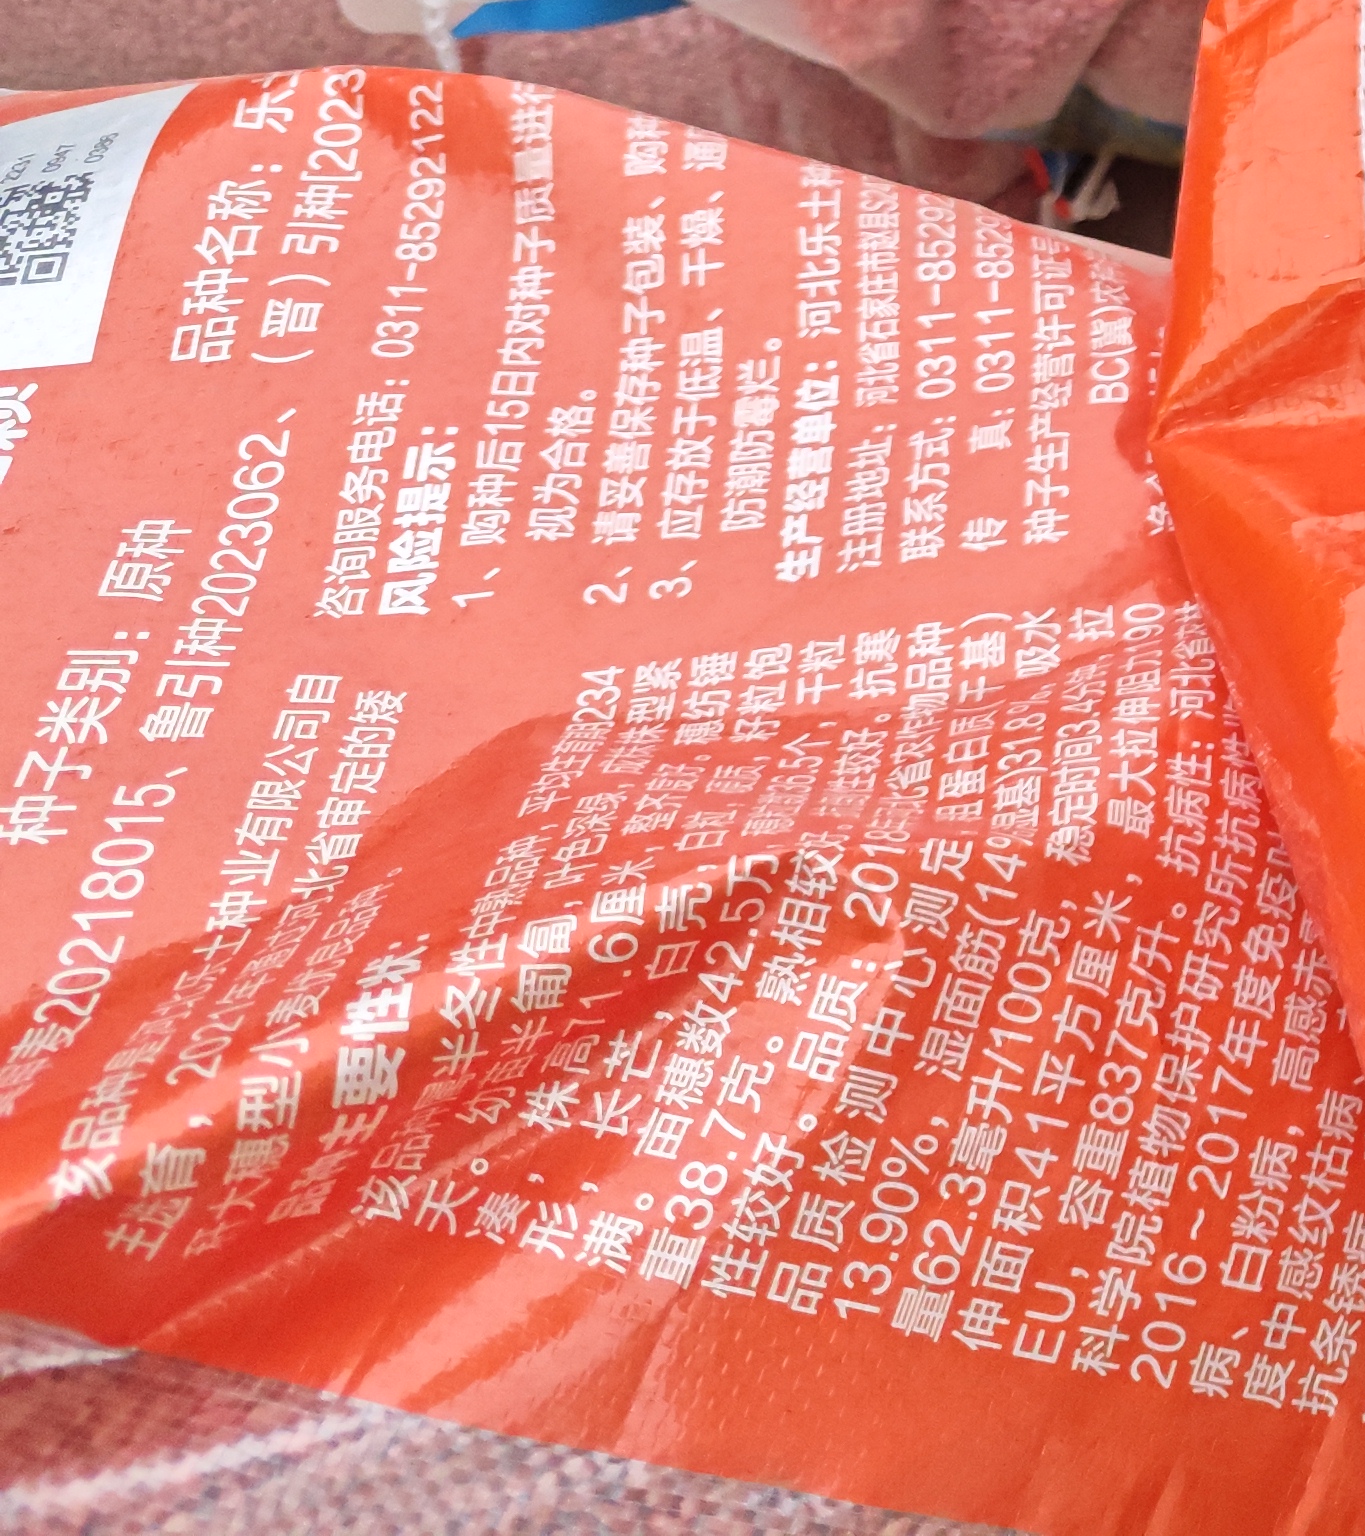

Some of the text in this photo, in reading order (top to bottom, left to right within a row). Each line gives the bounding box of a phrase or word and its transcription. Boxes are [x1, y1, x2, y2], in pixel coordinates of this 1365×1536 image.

[378, 420, 460, 614] 风险提示：
[528, 393, 599, 538] 视为合格。
[719, 334, 783, 528] 防潮防霉烂。
